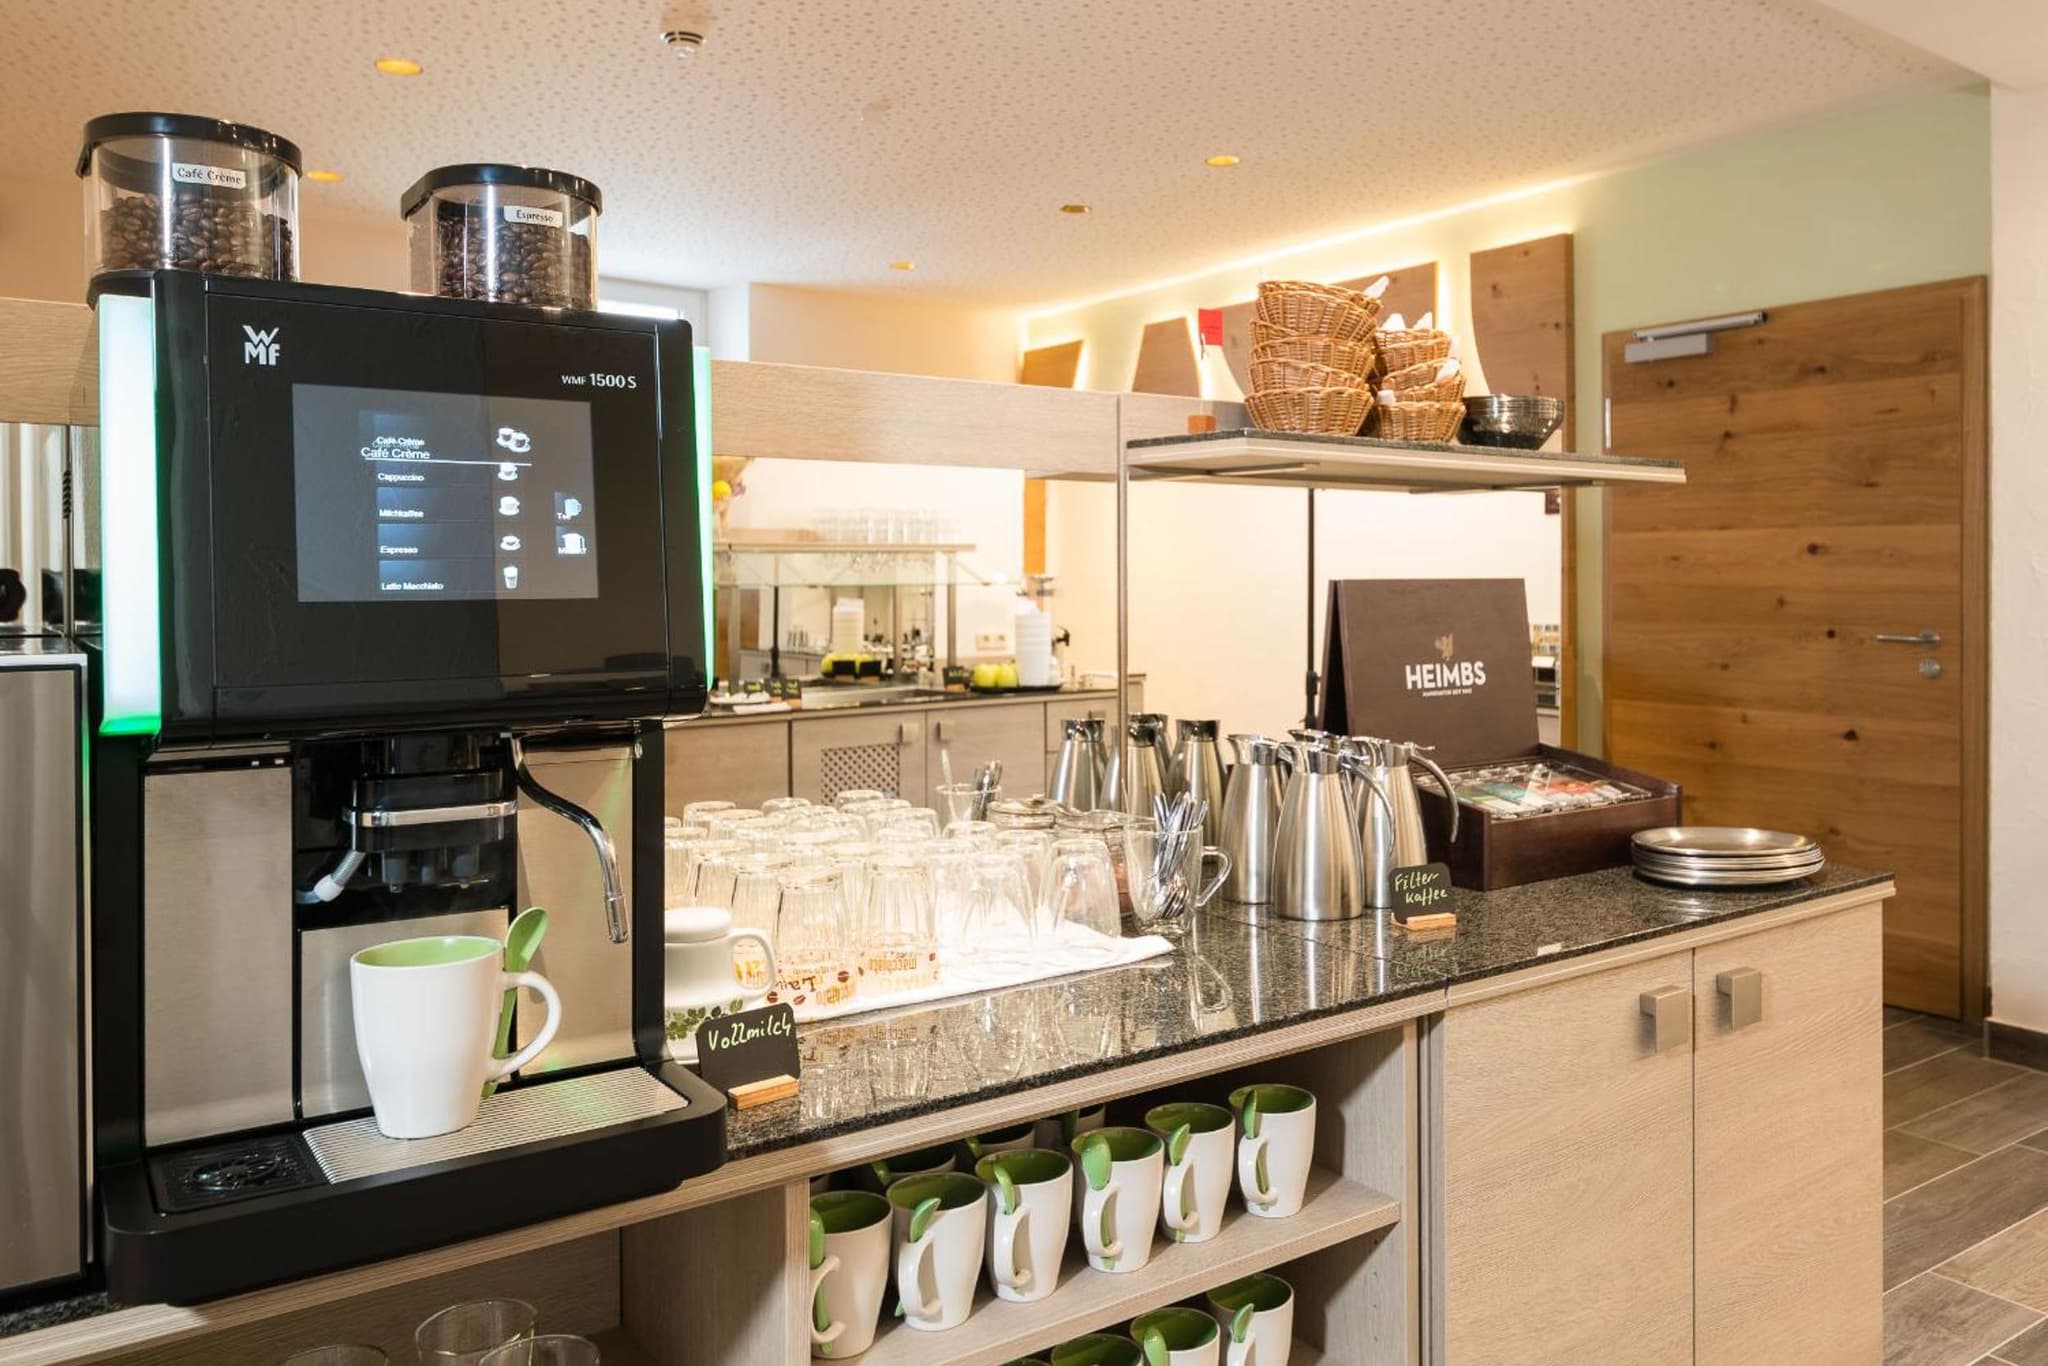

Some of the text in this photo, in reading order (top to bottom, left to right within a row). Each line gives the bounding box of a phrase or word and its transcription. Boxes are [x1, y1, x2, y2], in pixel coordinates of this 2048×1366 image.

[177, 167, 241, 184] Café Crème
[516, 209, 554, 223] Espresso
[242, 325, 281, 366] WMF
[561, 374, 587, 385] WMF
[589, 373, 626, 388] 1500
[361, 447, 431, 459] Café Crème
[377, 472, 425, 483] Cappuccino
[379, 509, 425, 518] Milchkaffee
[380, 545, 418, 554] Espresso
[381, 582, 444, 591] Latte Macchiato
[1405, 661, 1486, 690] HEIMBS
[708, 1012, 791, 1051] Vollmilch
